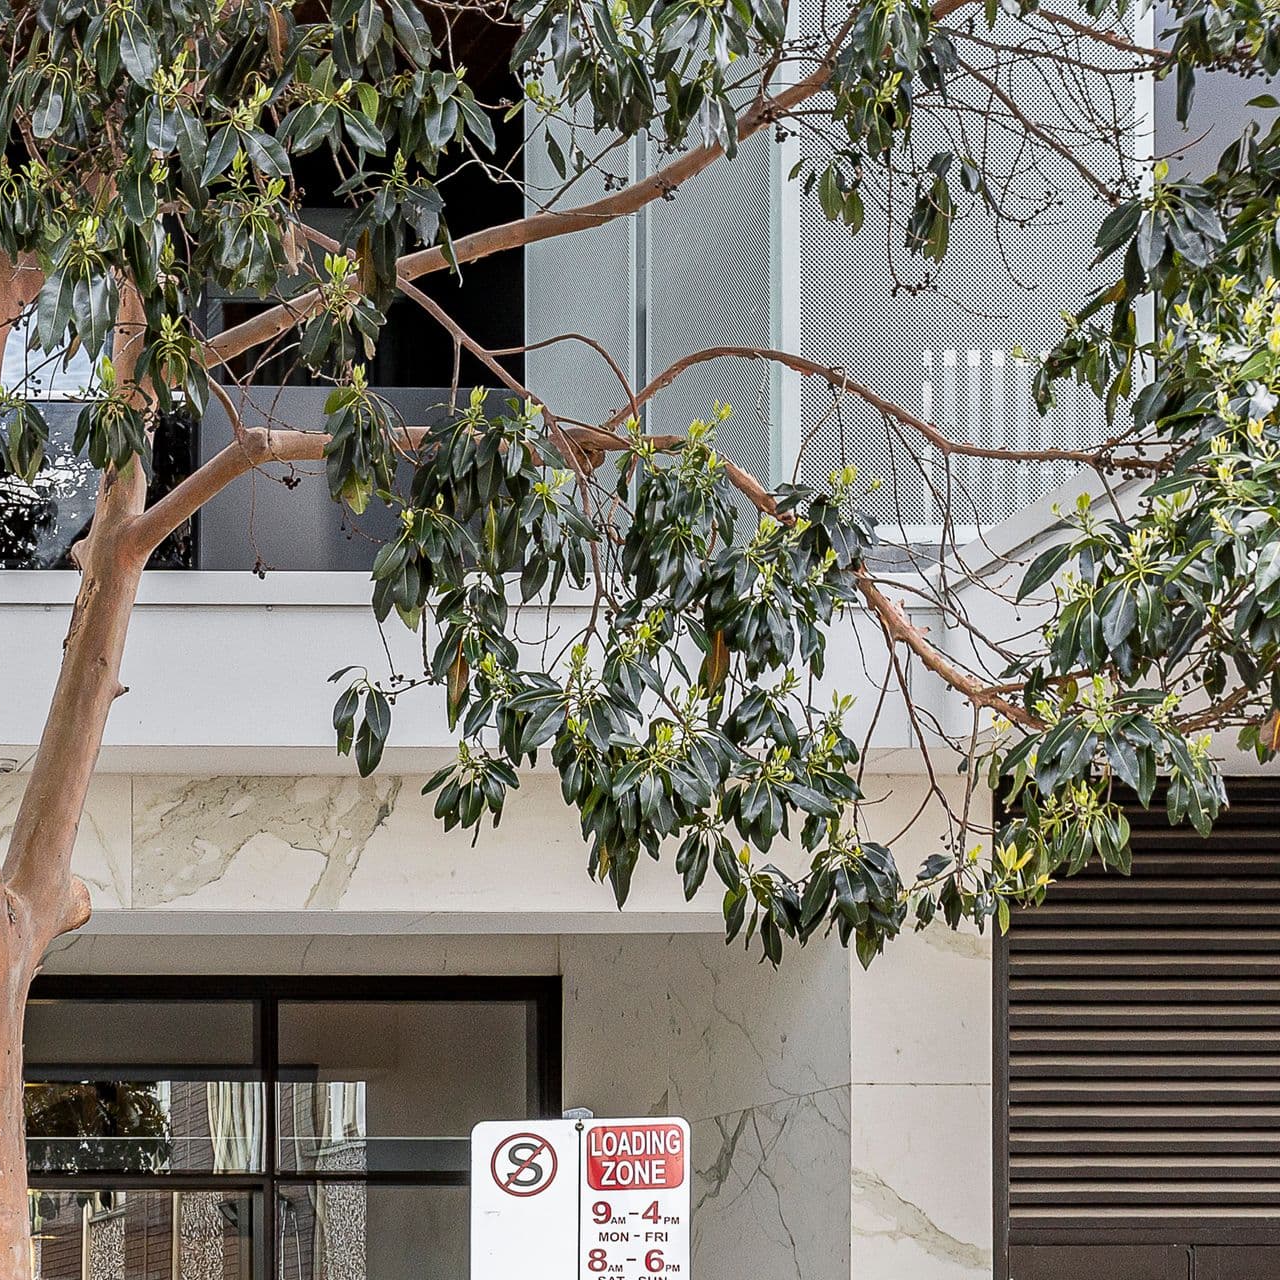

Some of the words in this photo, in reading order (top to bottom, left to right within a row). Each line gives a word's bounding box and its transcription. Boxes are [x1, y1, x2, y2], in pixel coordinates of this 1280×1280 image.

[591, 1129, 681, 1157] LOADING
[601, 1160, 667, 1186] ZONE
[598, 1231, 630, 1242] MON
[644, 1231, 669, 1242] FRI
